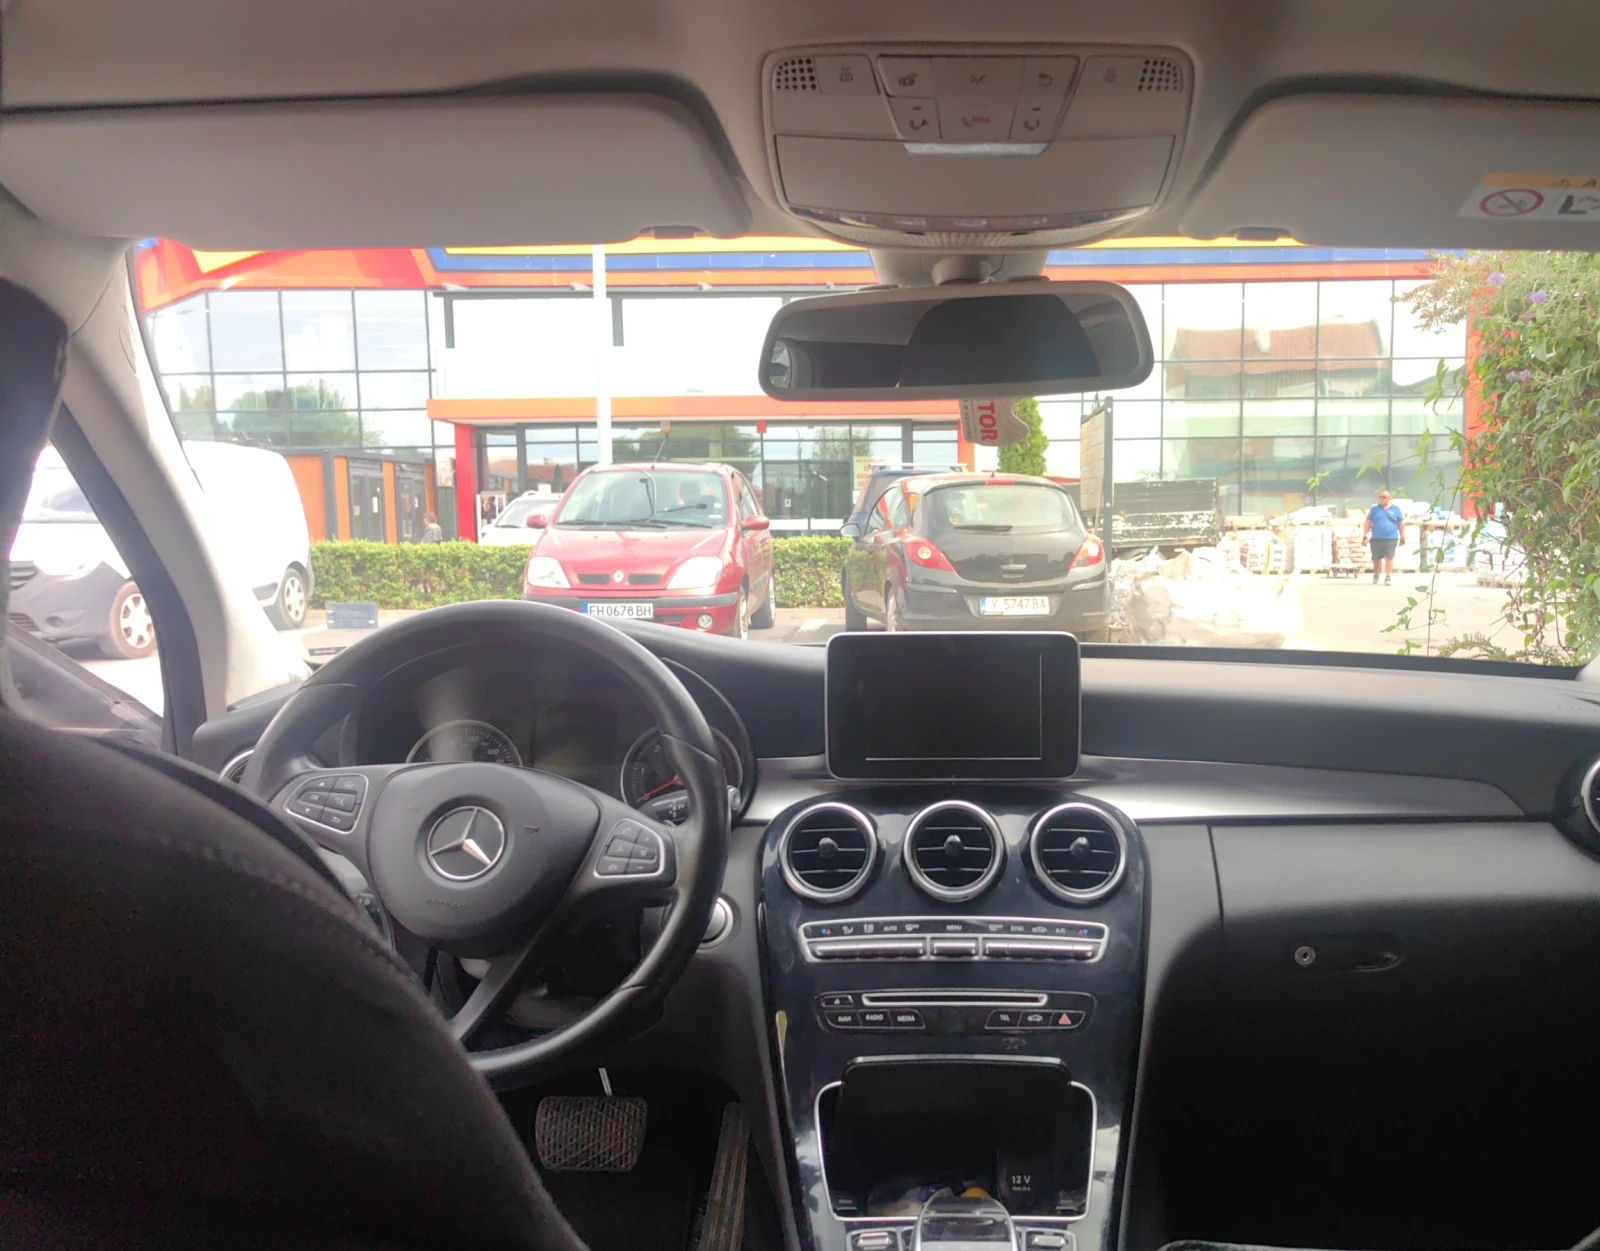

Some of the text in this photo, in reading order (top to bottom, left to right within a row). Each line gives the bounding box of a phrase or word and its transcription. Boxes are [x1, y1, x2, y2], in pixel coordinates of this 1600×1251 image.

[865, 1013, 884, 1021] RADIO
[897, 1014, 916, 1022] MEDIA
[1012, 1174, 1022, 1184] 12
